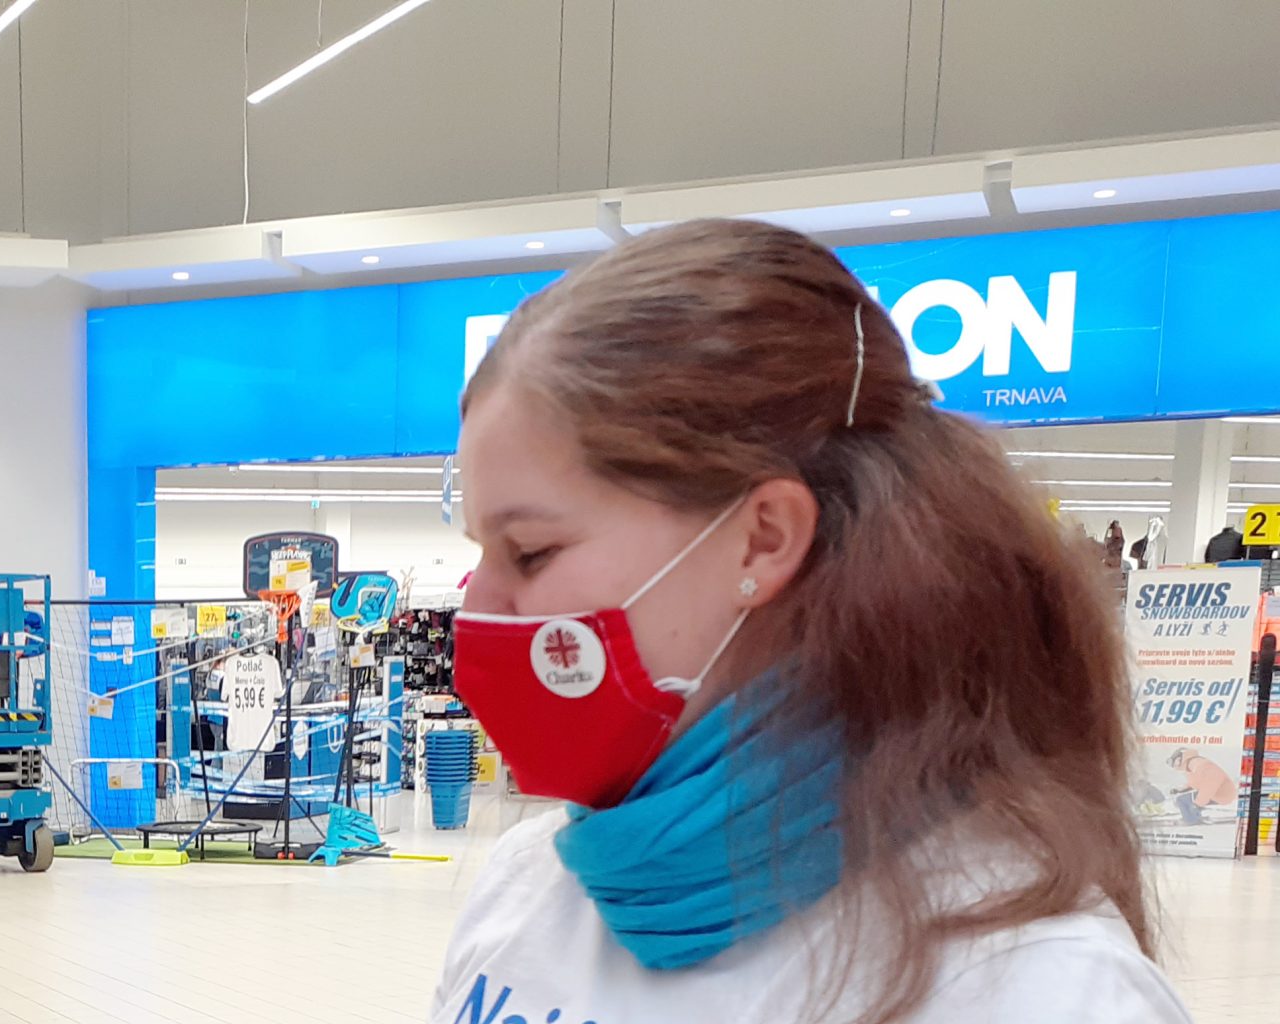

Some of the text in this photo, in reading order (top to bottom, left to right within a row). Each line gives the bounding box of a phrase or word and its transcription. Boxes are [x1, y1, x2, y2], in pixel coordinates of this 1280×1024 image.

[865, 271, 1077, 381] ON
[982, 386, 1068, 407] TRNAVA
[1135, 582, 1231, 609] SERVIS
[1141, 606, 1251, 620] SNOWBOARDOV
[1153, 623, 1162, 636] A
[237, 660, 263, 672] Potlač
[1144, 678, 1236, 697] Servis od
[235, 687, 265, 712] 5,99 €
[1140, 699, 1226, 726] 11,99 €
